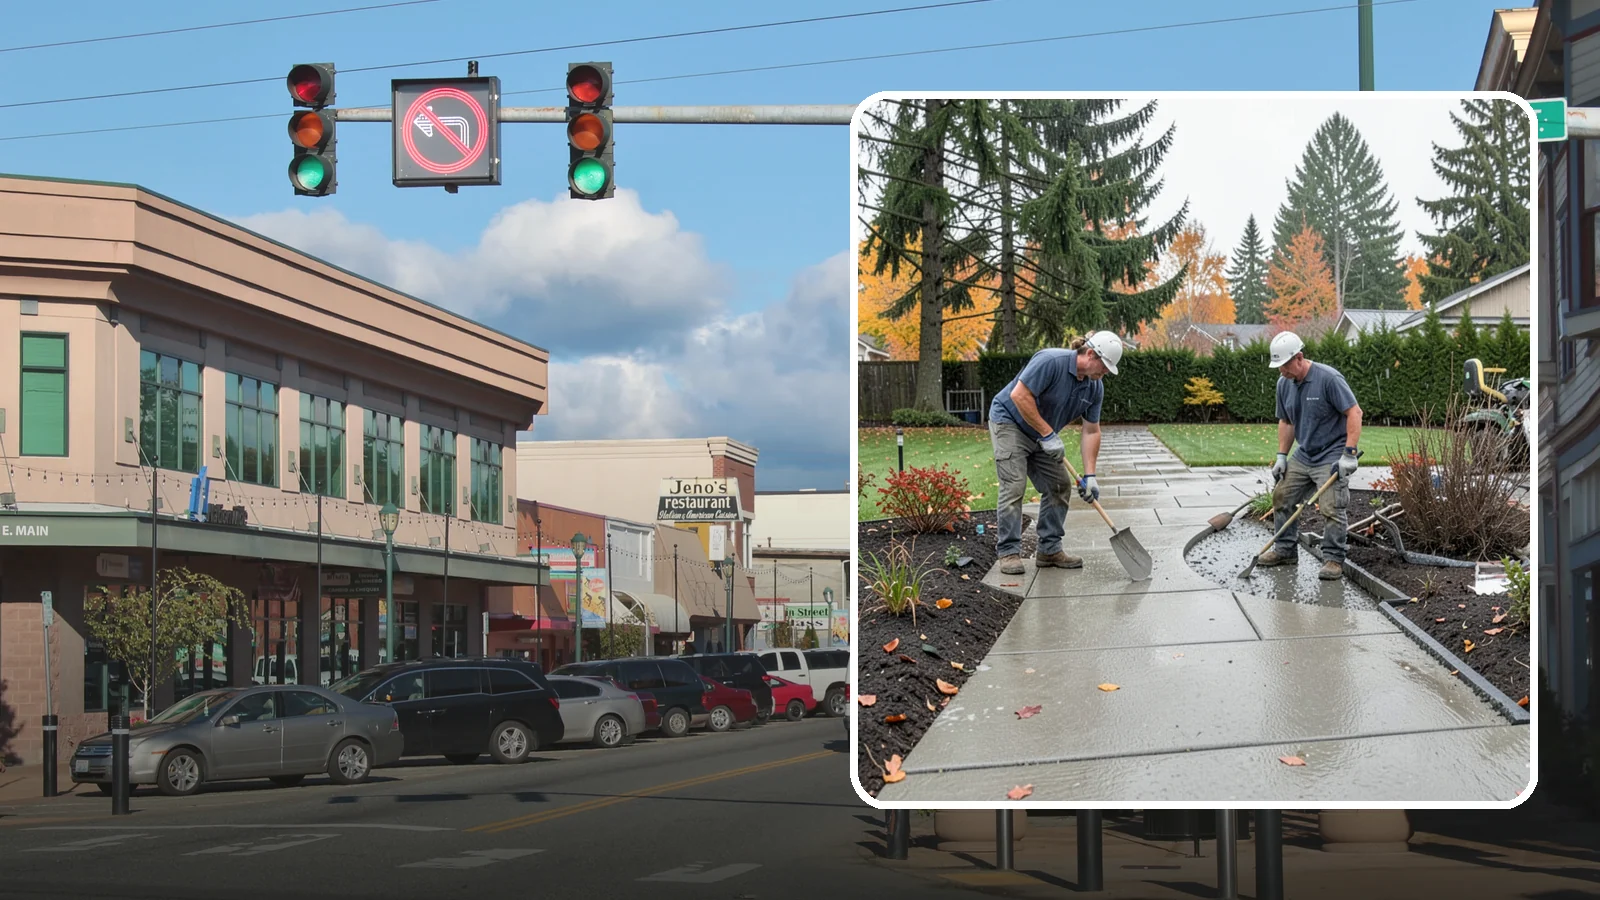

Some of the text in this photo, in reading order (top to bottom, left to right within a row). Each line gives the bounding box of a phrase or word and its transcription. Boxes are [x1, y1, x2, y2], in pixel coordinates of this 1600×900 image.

[669, 479, 728, 495] Jeno's
[664, 496, 731, 509] restaurant
[658, 509, 682, 520] Italian
[686, 509, 714, 519] American
[715, 509, 737, 519] Cuisine
[2, 525, 49, 536] E. MAIN
[785, 607, 794, 616] in
[797, 607, 828, 616] Street
[791, 619, 823, 627] lass
